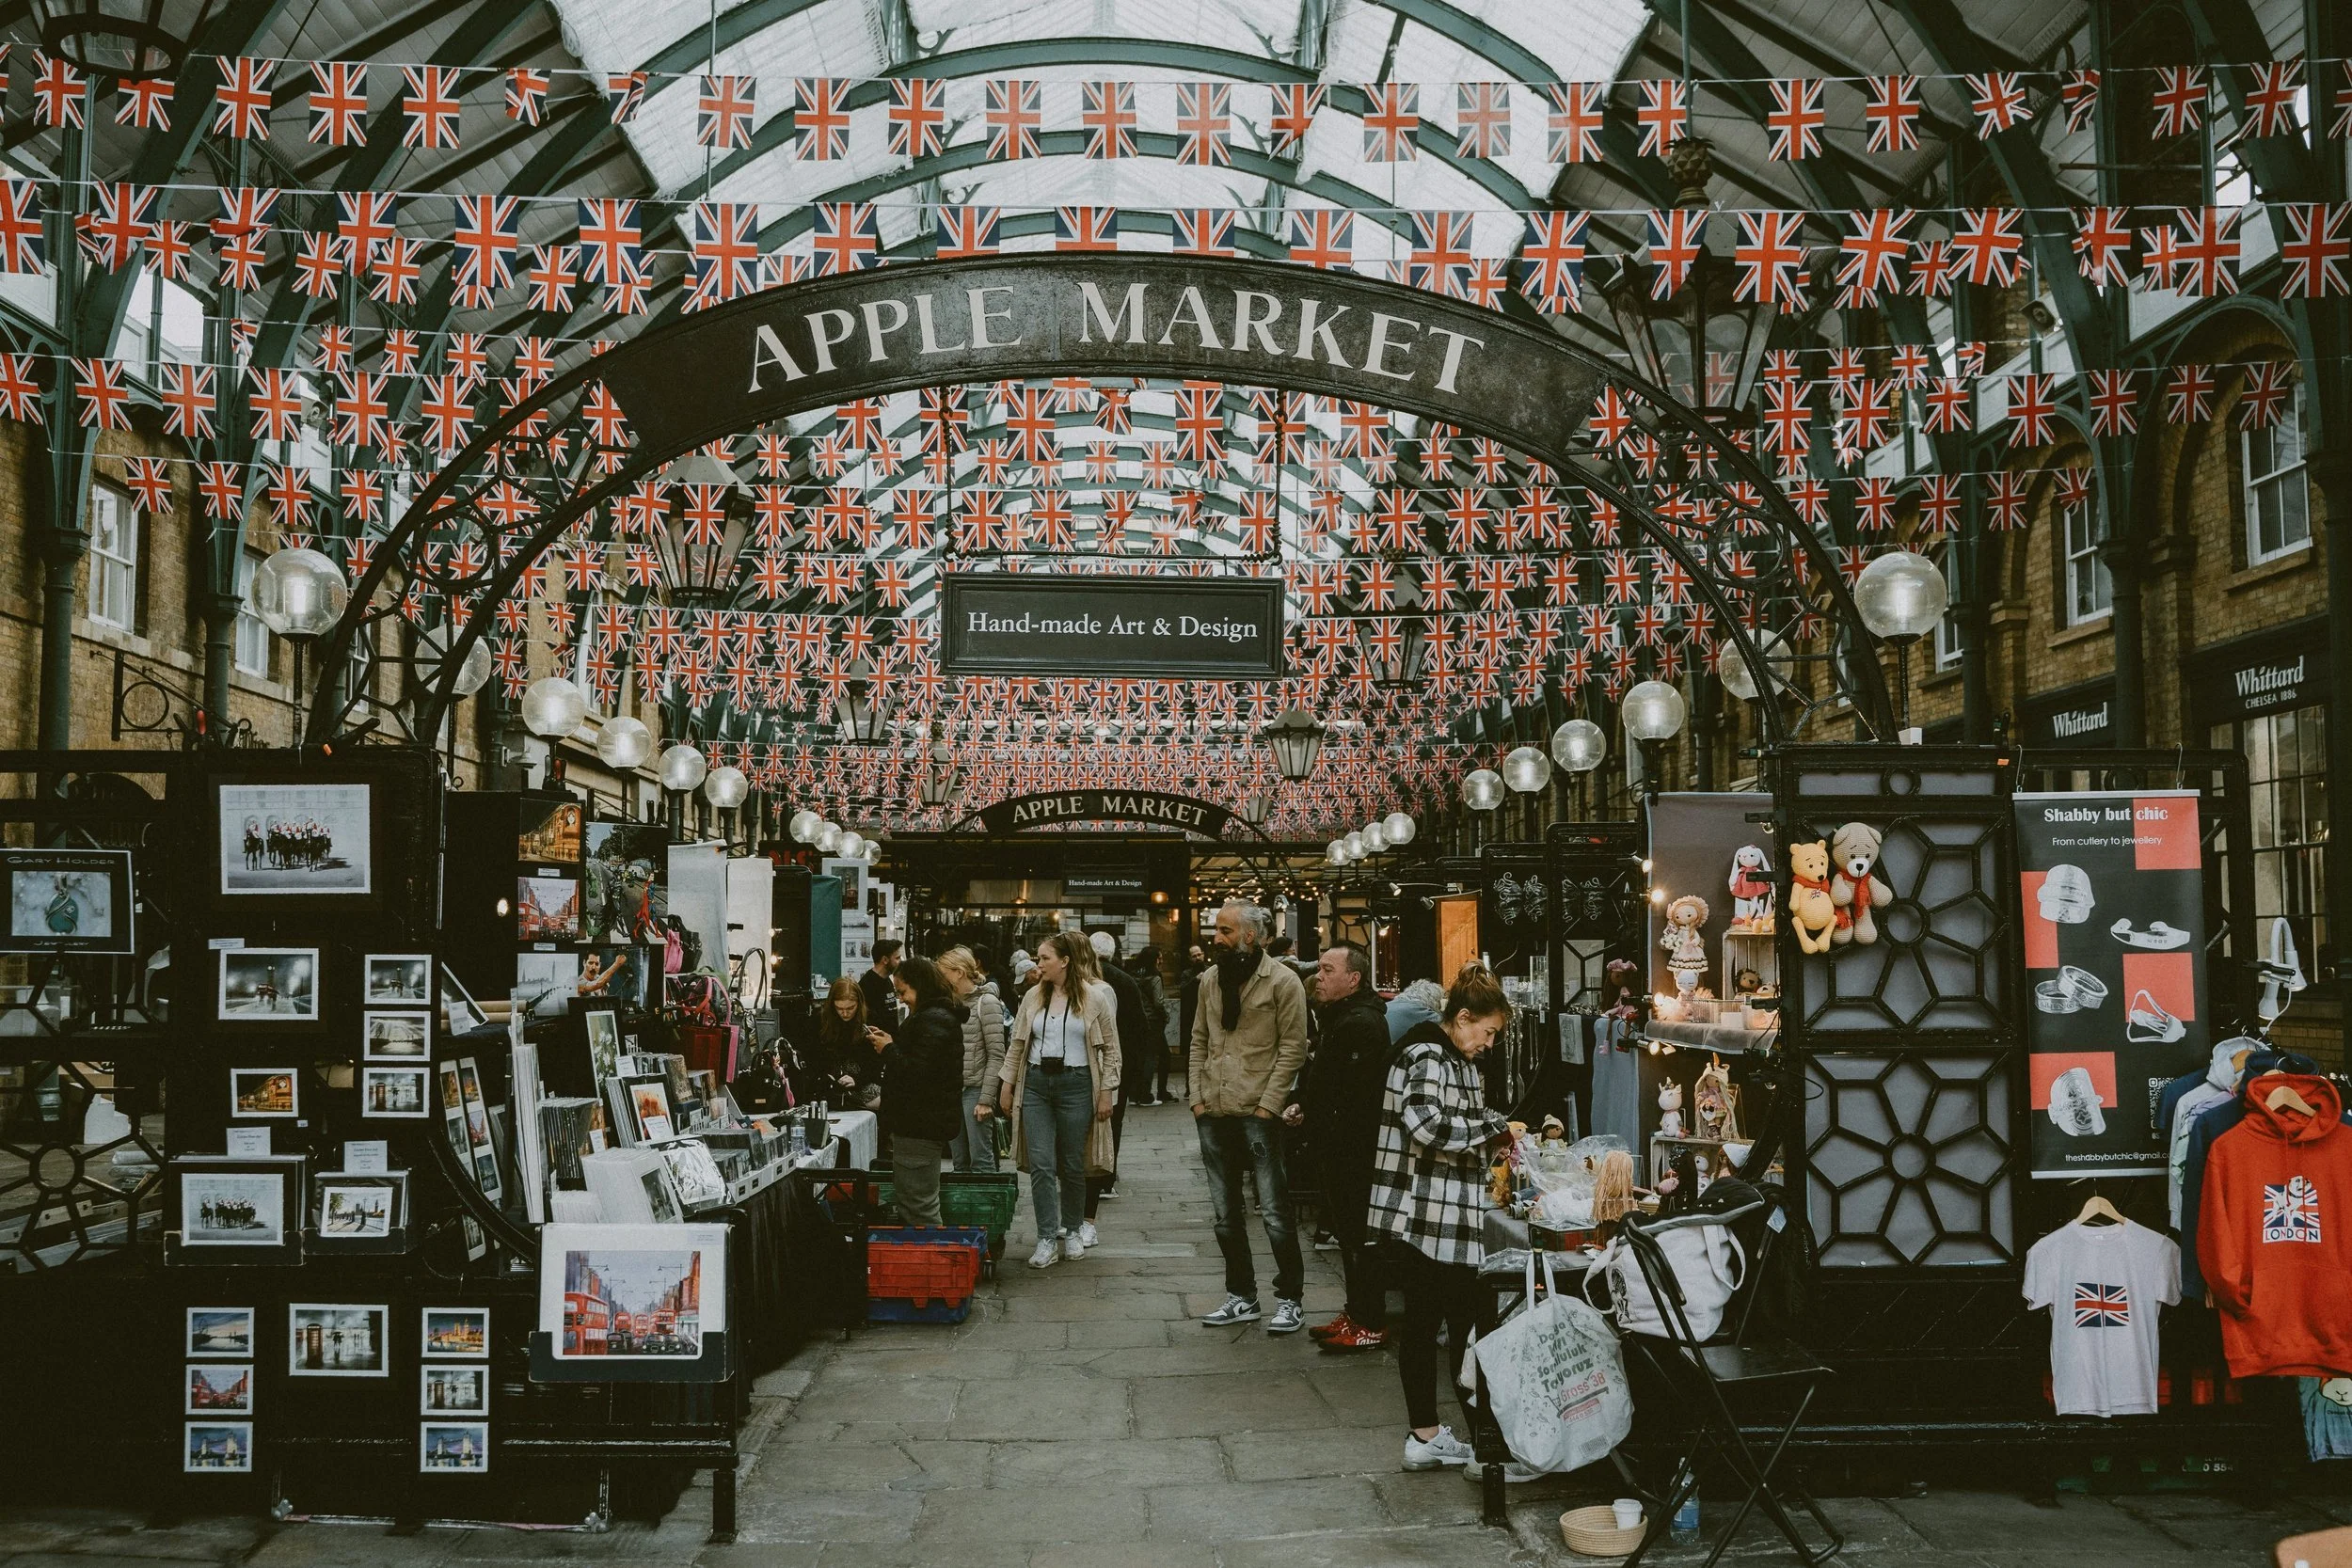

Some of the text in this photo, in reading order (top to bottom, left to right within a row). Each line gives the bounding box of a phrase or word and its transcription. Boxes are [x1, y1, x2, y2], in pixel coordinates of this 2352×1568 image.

[749, 280, 1486, 395] APPLE MARKET
[967, 611, 1258, 642] Hand-made Art & Design
[2235, 655, 2305, 697] Whittard
[2246, 689, 2296, 708] CHELSEA 1886
[2053, 702, 2108, 738] Whittard
[1013, 796, 1208, 826] APPLE MARKET
[2043, 806, 2169, 824] Shabby but chic
[2052, 835, 2163, 847] From cutlery to jewellery
[2065, 1151, 2170, 1163] theshabbybutchic@gmail.co
[2265, 1227, 2318, 1241] LONDON
[1560, 1381, 1590, 1403] Gross
